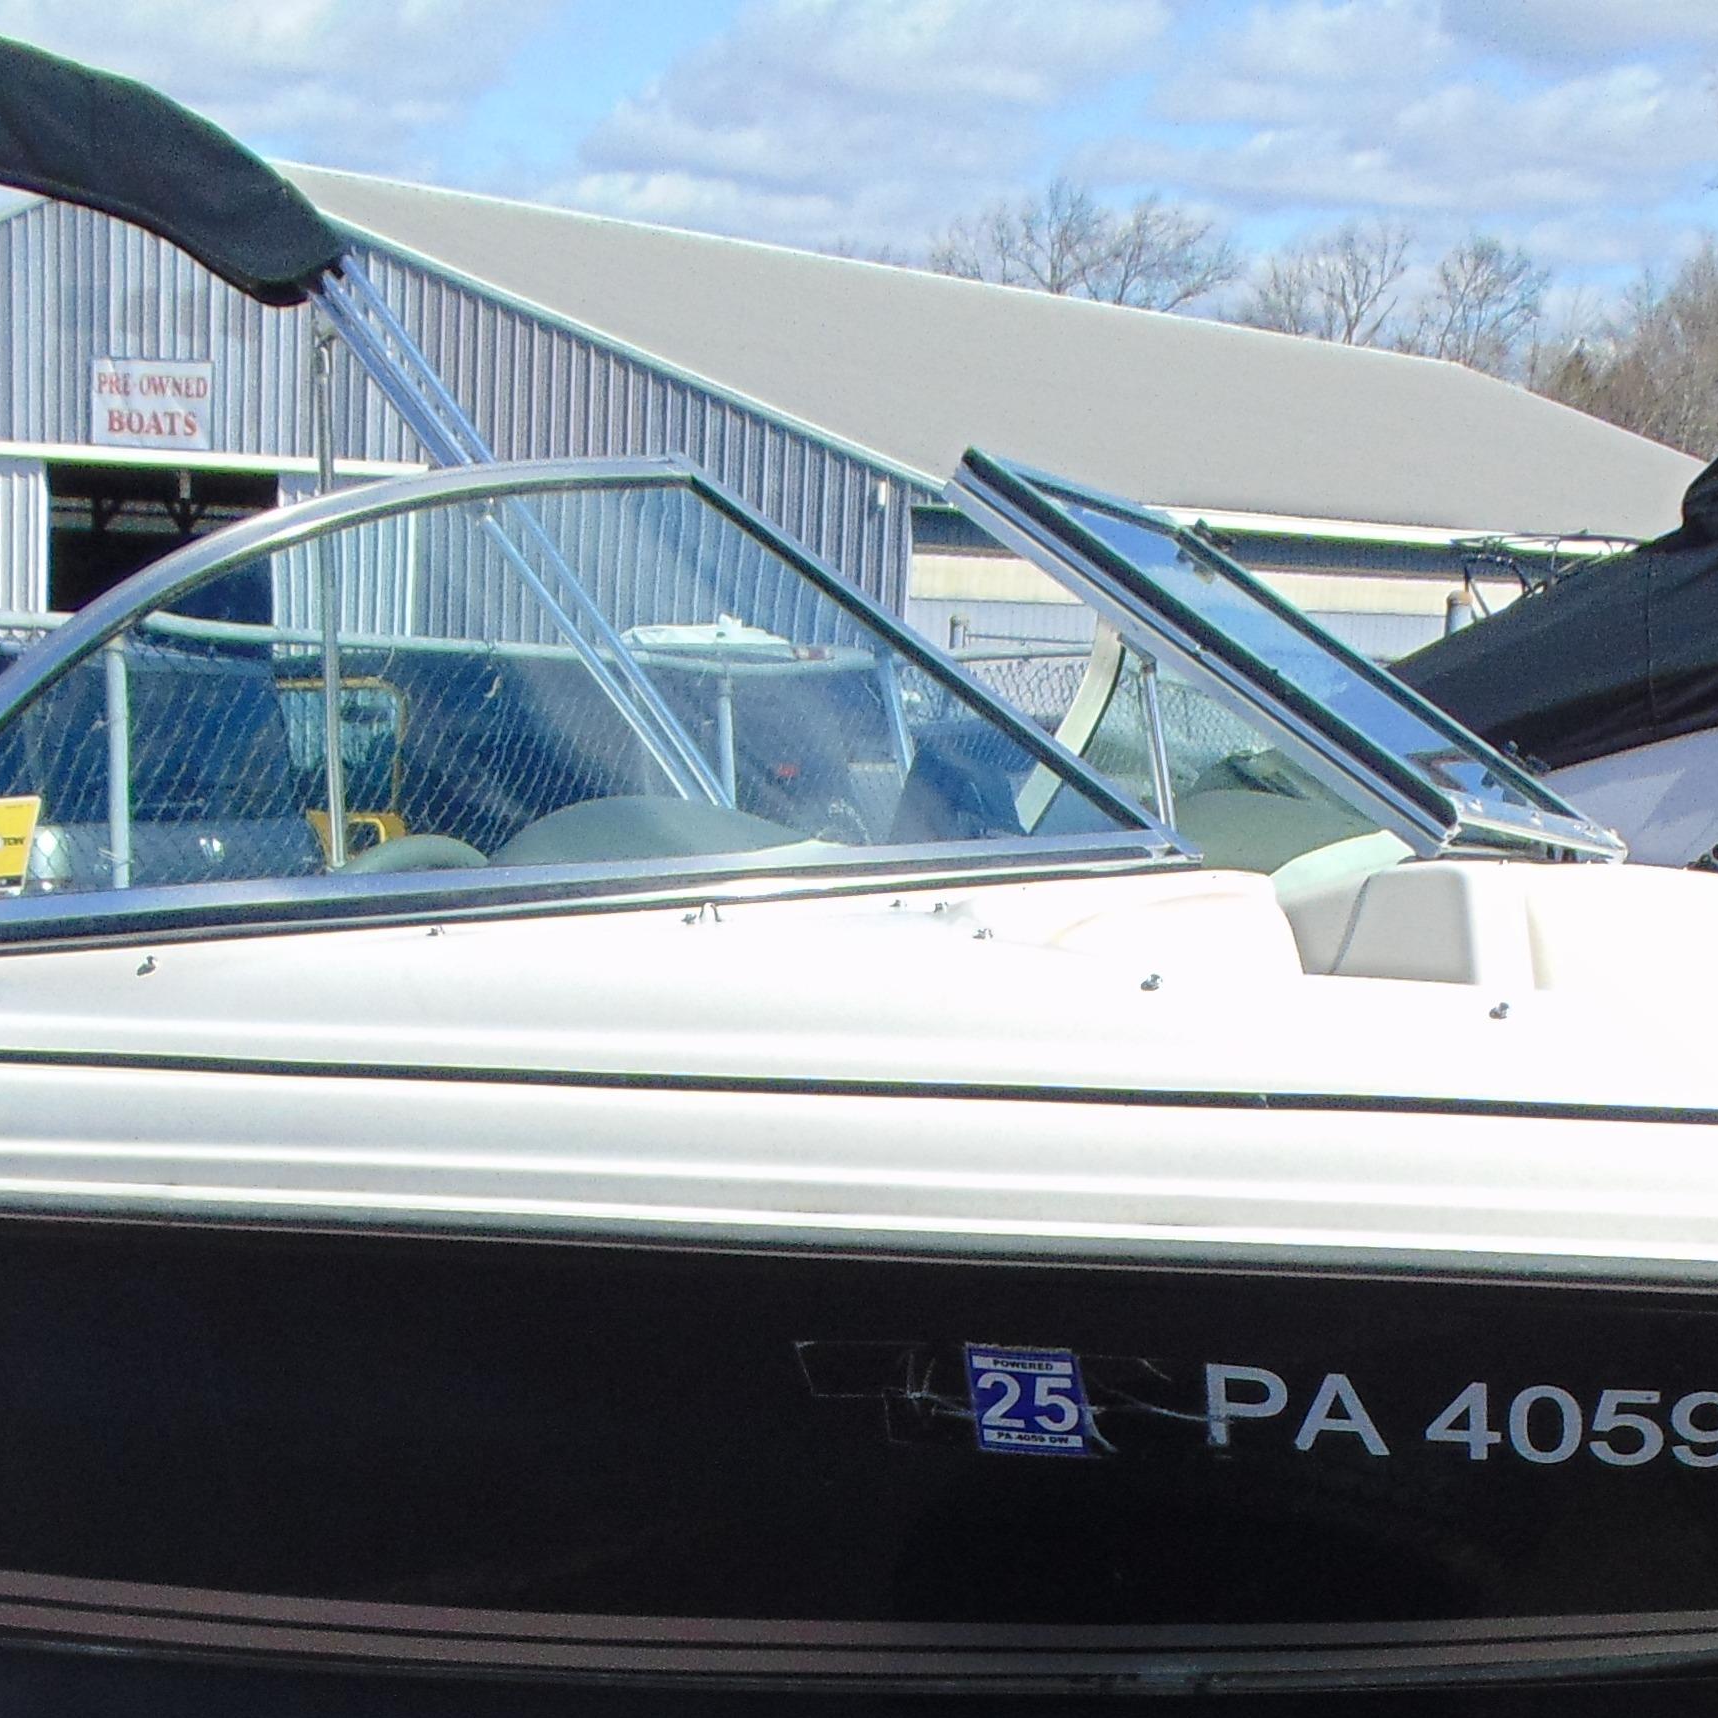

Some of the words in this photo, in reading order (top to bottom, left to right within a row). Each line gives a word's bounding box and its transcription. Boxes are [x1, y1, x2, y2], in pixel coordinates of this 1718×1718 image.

[108, 409, 197, 436] BOATS
[992, 1359, 1054, 1371] POWERED
[976, 1372, 1079, 1432] 25
[1205, 1361, 1390, 1457] PA
